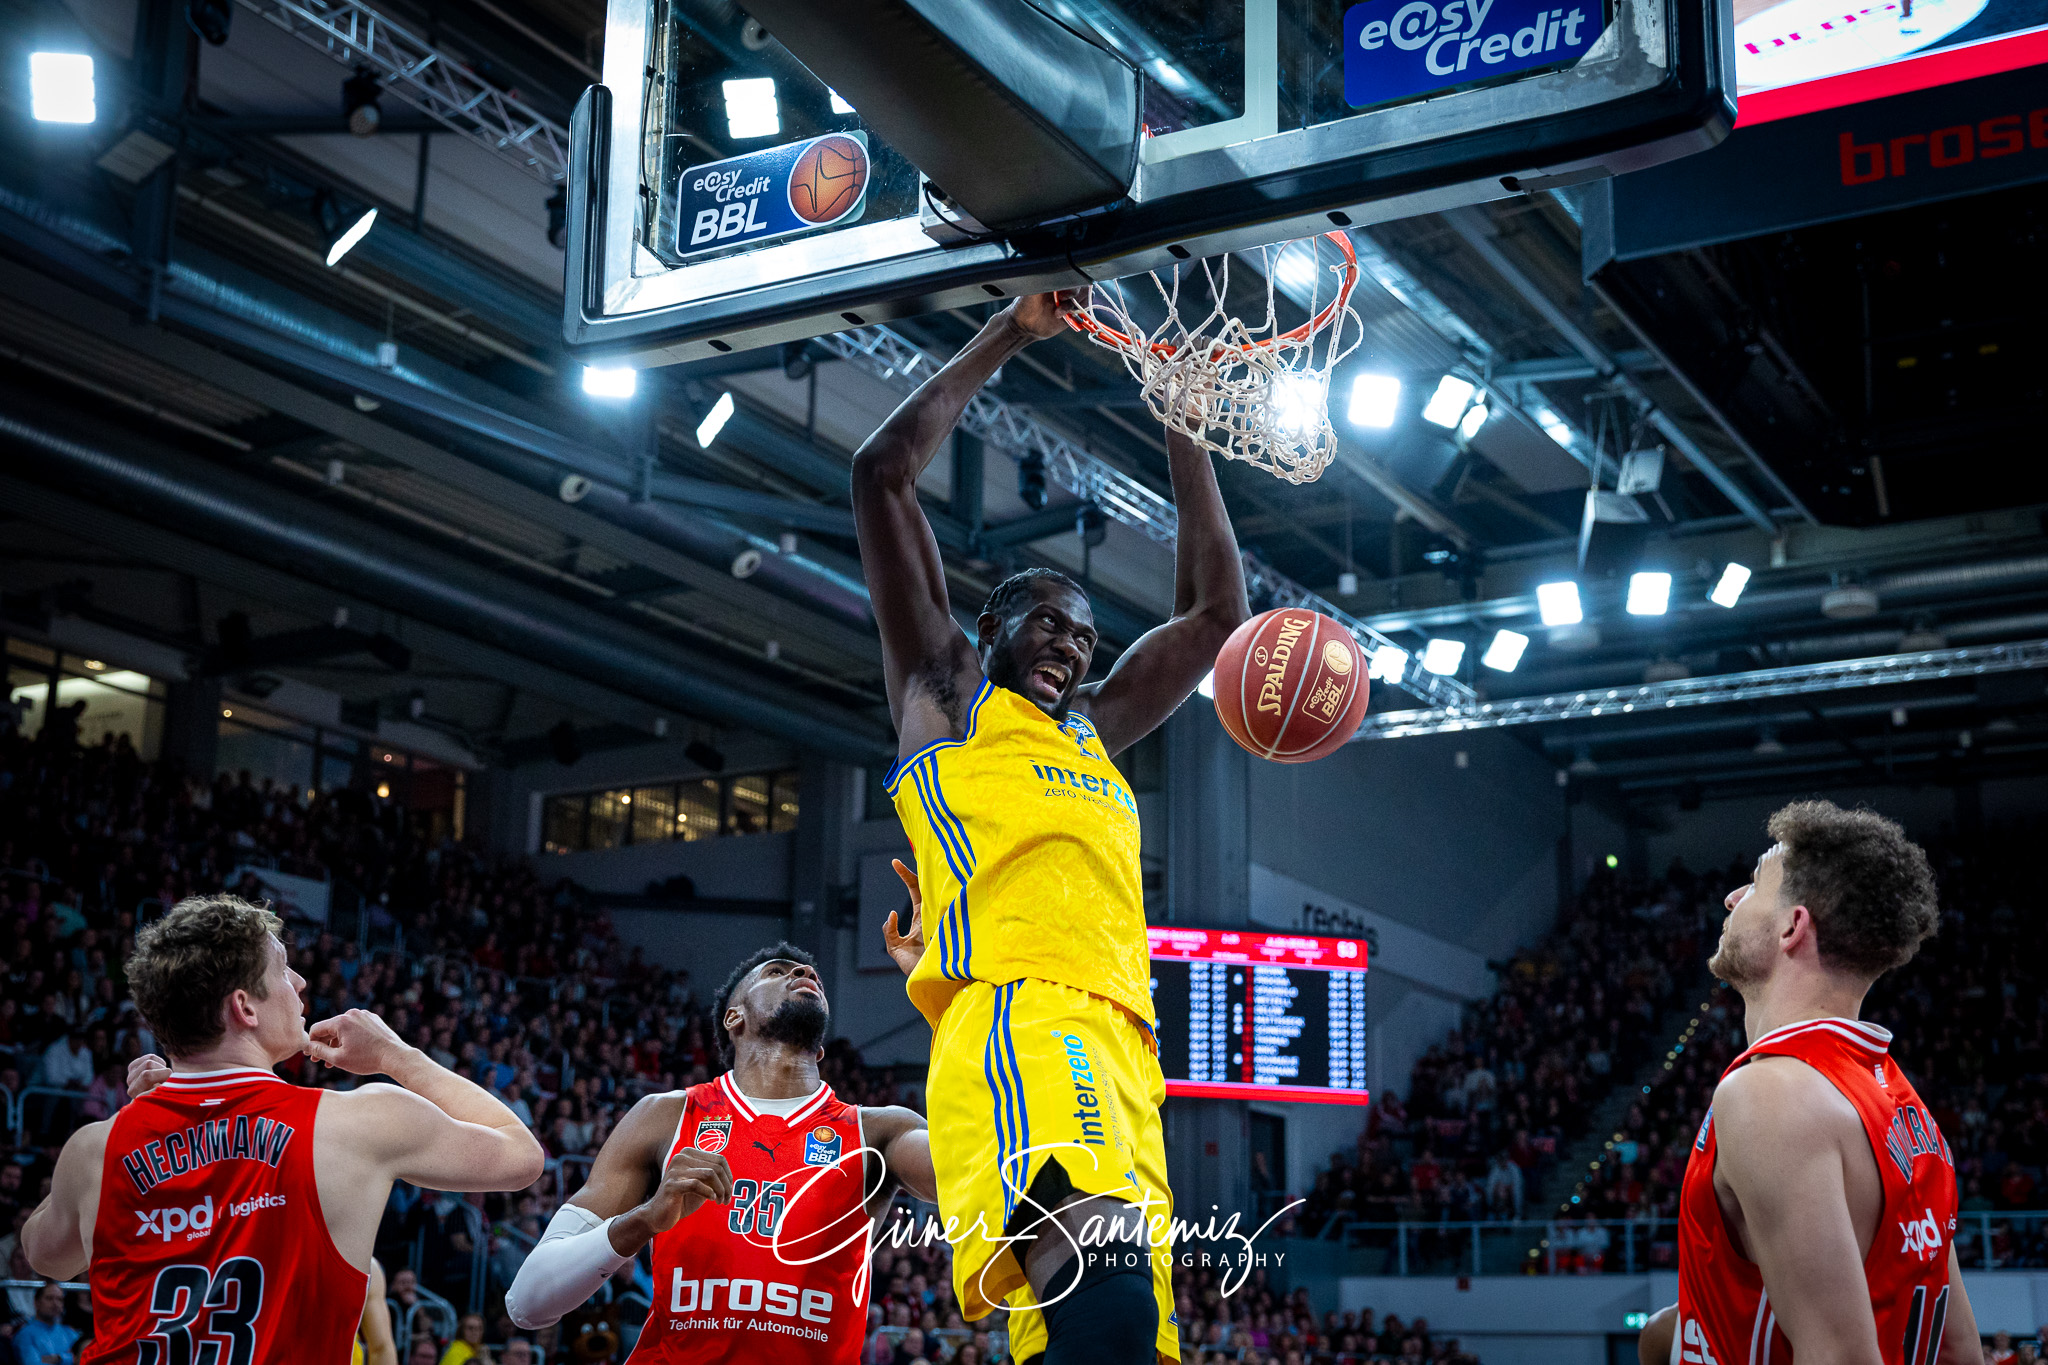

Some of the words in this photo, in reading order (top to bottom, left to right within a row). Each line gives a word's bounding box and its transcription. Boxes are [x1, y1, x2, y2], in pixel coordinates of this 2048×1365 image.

[1425, 8, 1586, 76] Credit
[715, 175, 771, 203] Credit
[690, 198, 768, 246] BBL
[1257, 617, 1313, 717] SPALDING
[1321, 684, 1345, 718] BBL
[1029, 759, 1136, 814] interze
[1043, 787, 1077, 799] zero
[1063, 1034, 1106, 1146] interzero
[122, 1115, 295, 1195] HECKMANN
[808, 1152, 834, 1165] BBL
[134, 1195, 214, 1242] xpd
[229, 1192, 286, 1218] logistics
[728, 1178, 787, 1238] 35
[1898, 1208, 1943, 1261] xpd
[186, 1229, 211, 1242] global
[136, 1256, 265, 1365] 33
[670, 1266, 833, 1324] brose
[669, 1316, 719, 1331] Technik
[723, 1316, 743, 1330] für
[746, 1317, 829, 1343] Automobile
